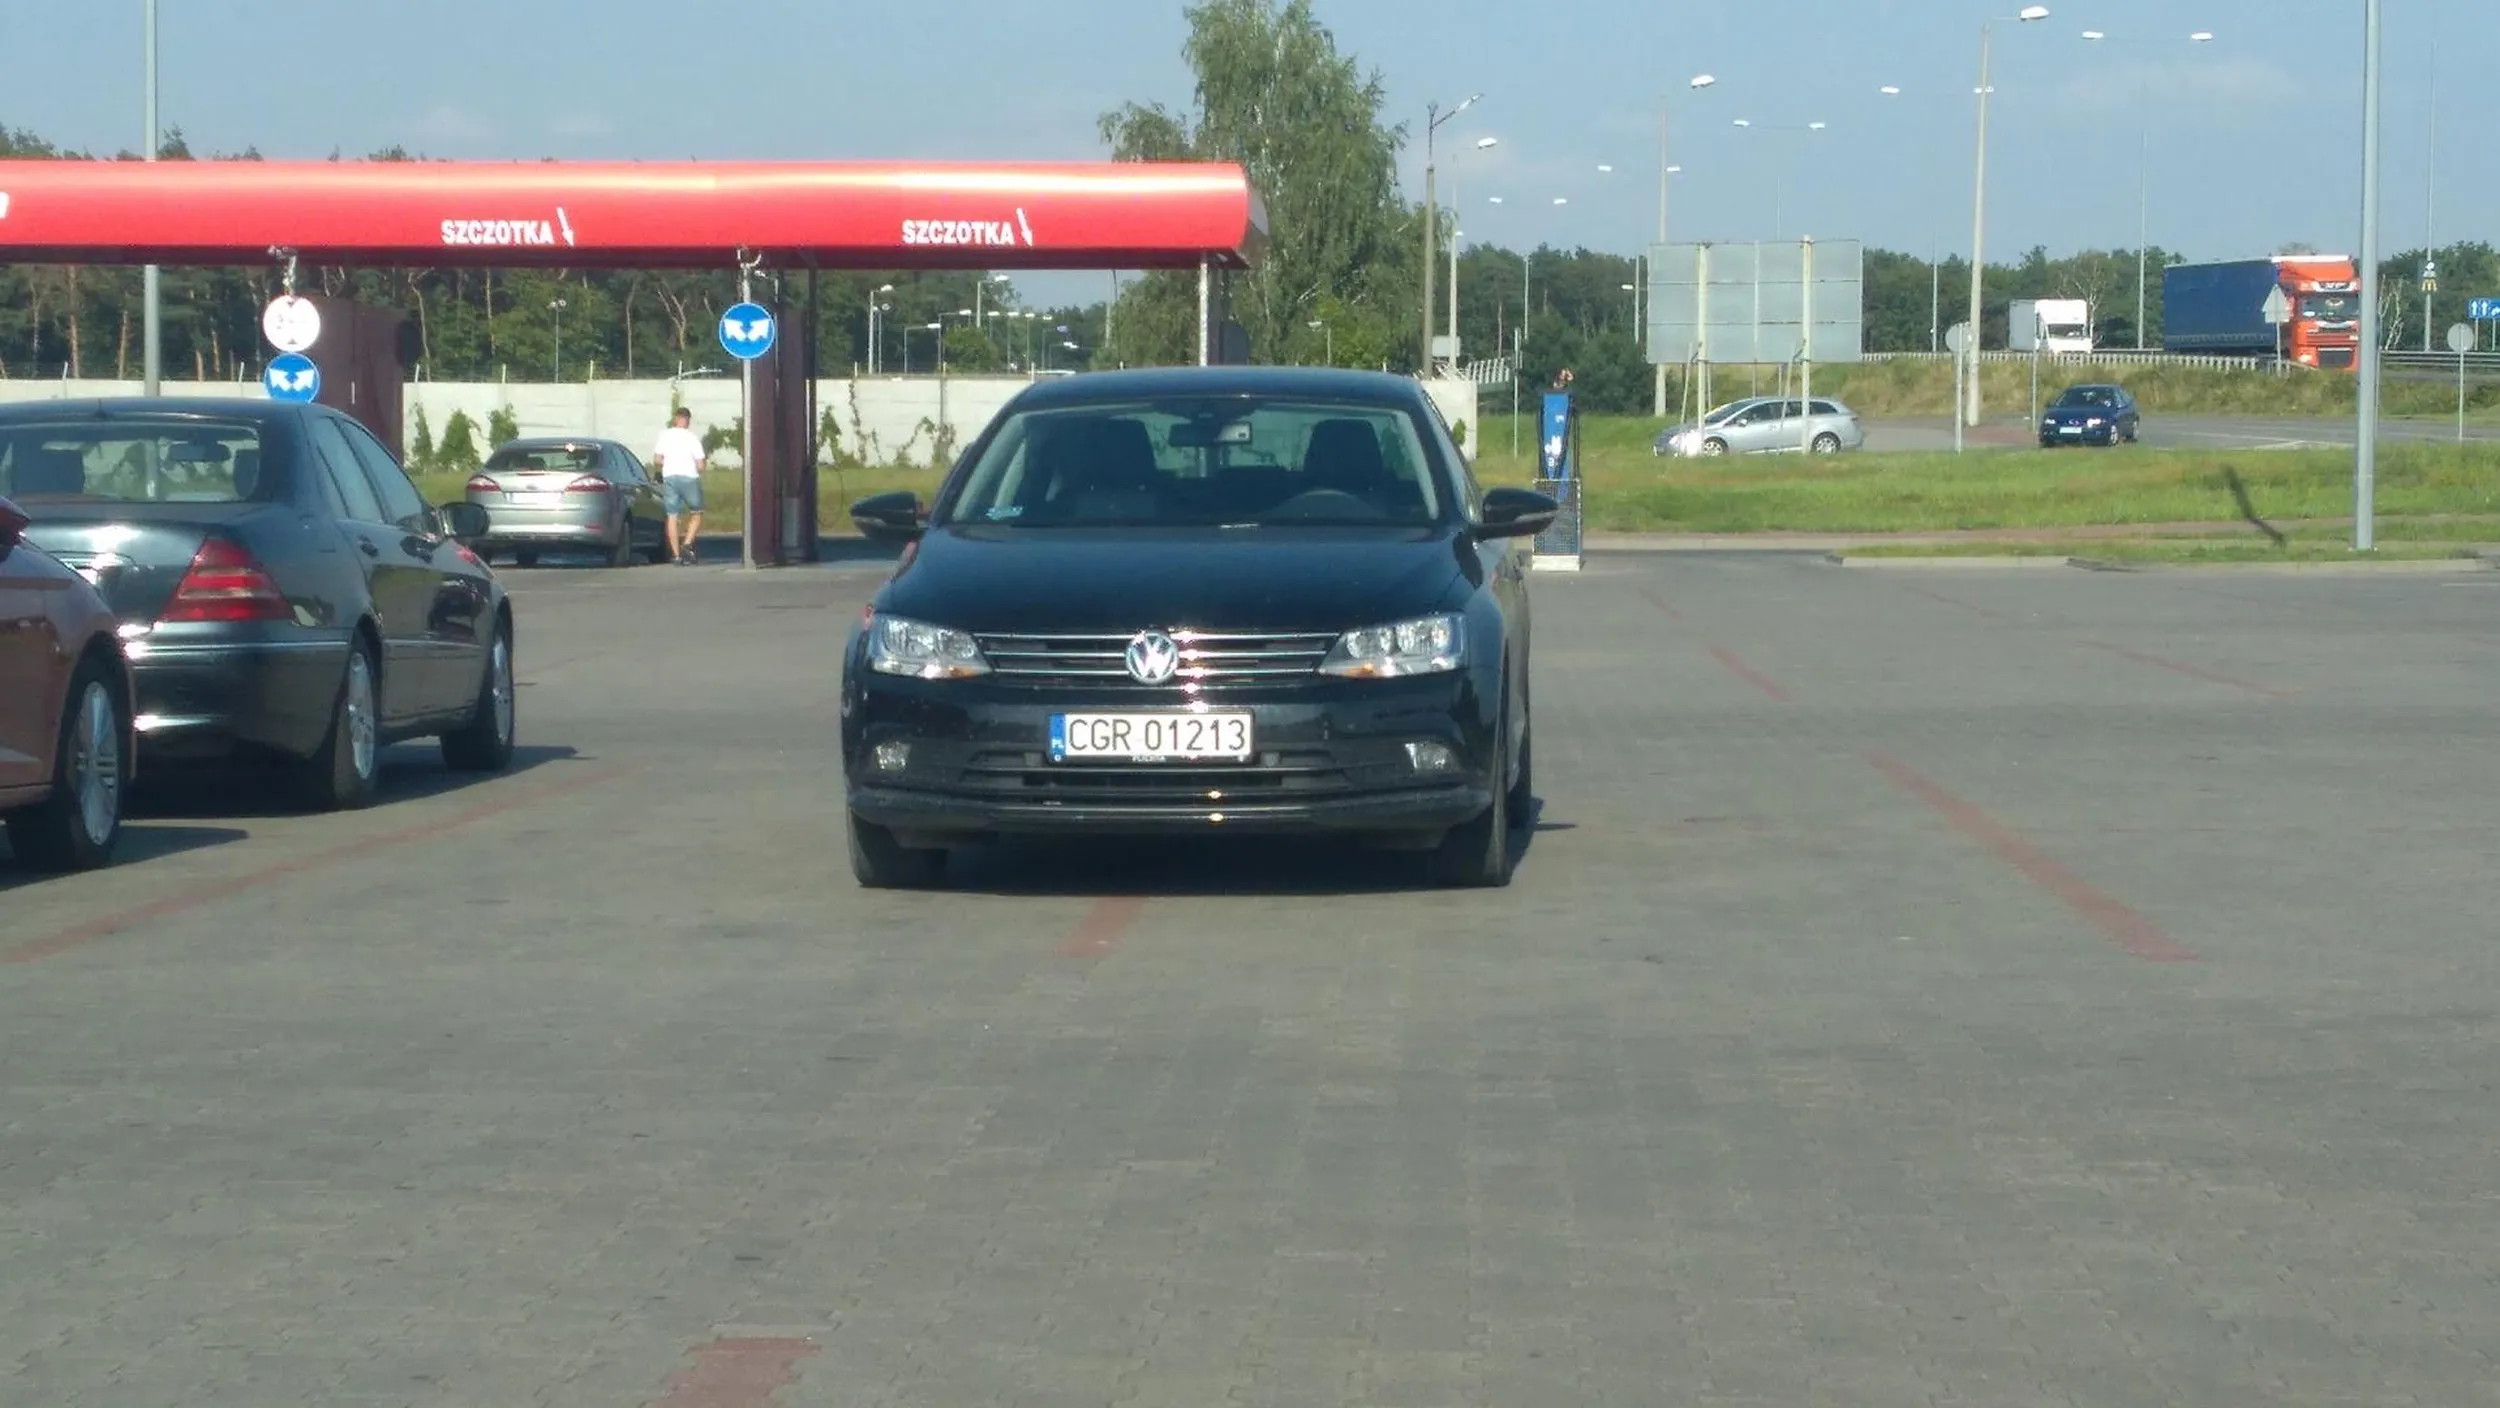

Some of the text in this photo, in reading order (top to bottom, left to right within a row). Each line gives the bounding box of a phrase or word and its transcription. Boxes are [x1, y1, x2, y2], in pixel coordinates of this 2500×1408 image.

[441, 219, 554, 245] SZCZOTKA
[902, 219, 1015, 245] SZCZOTKA
[1069, 718, 1246, 751] CGR 01213
